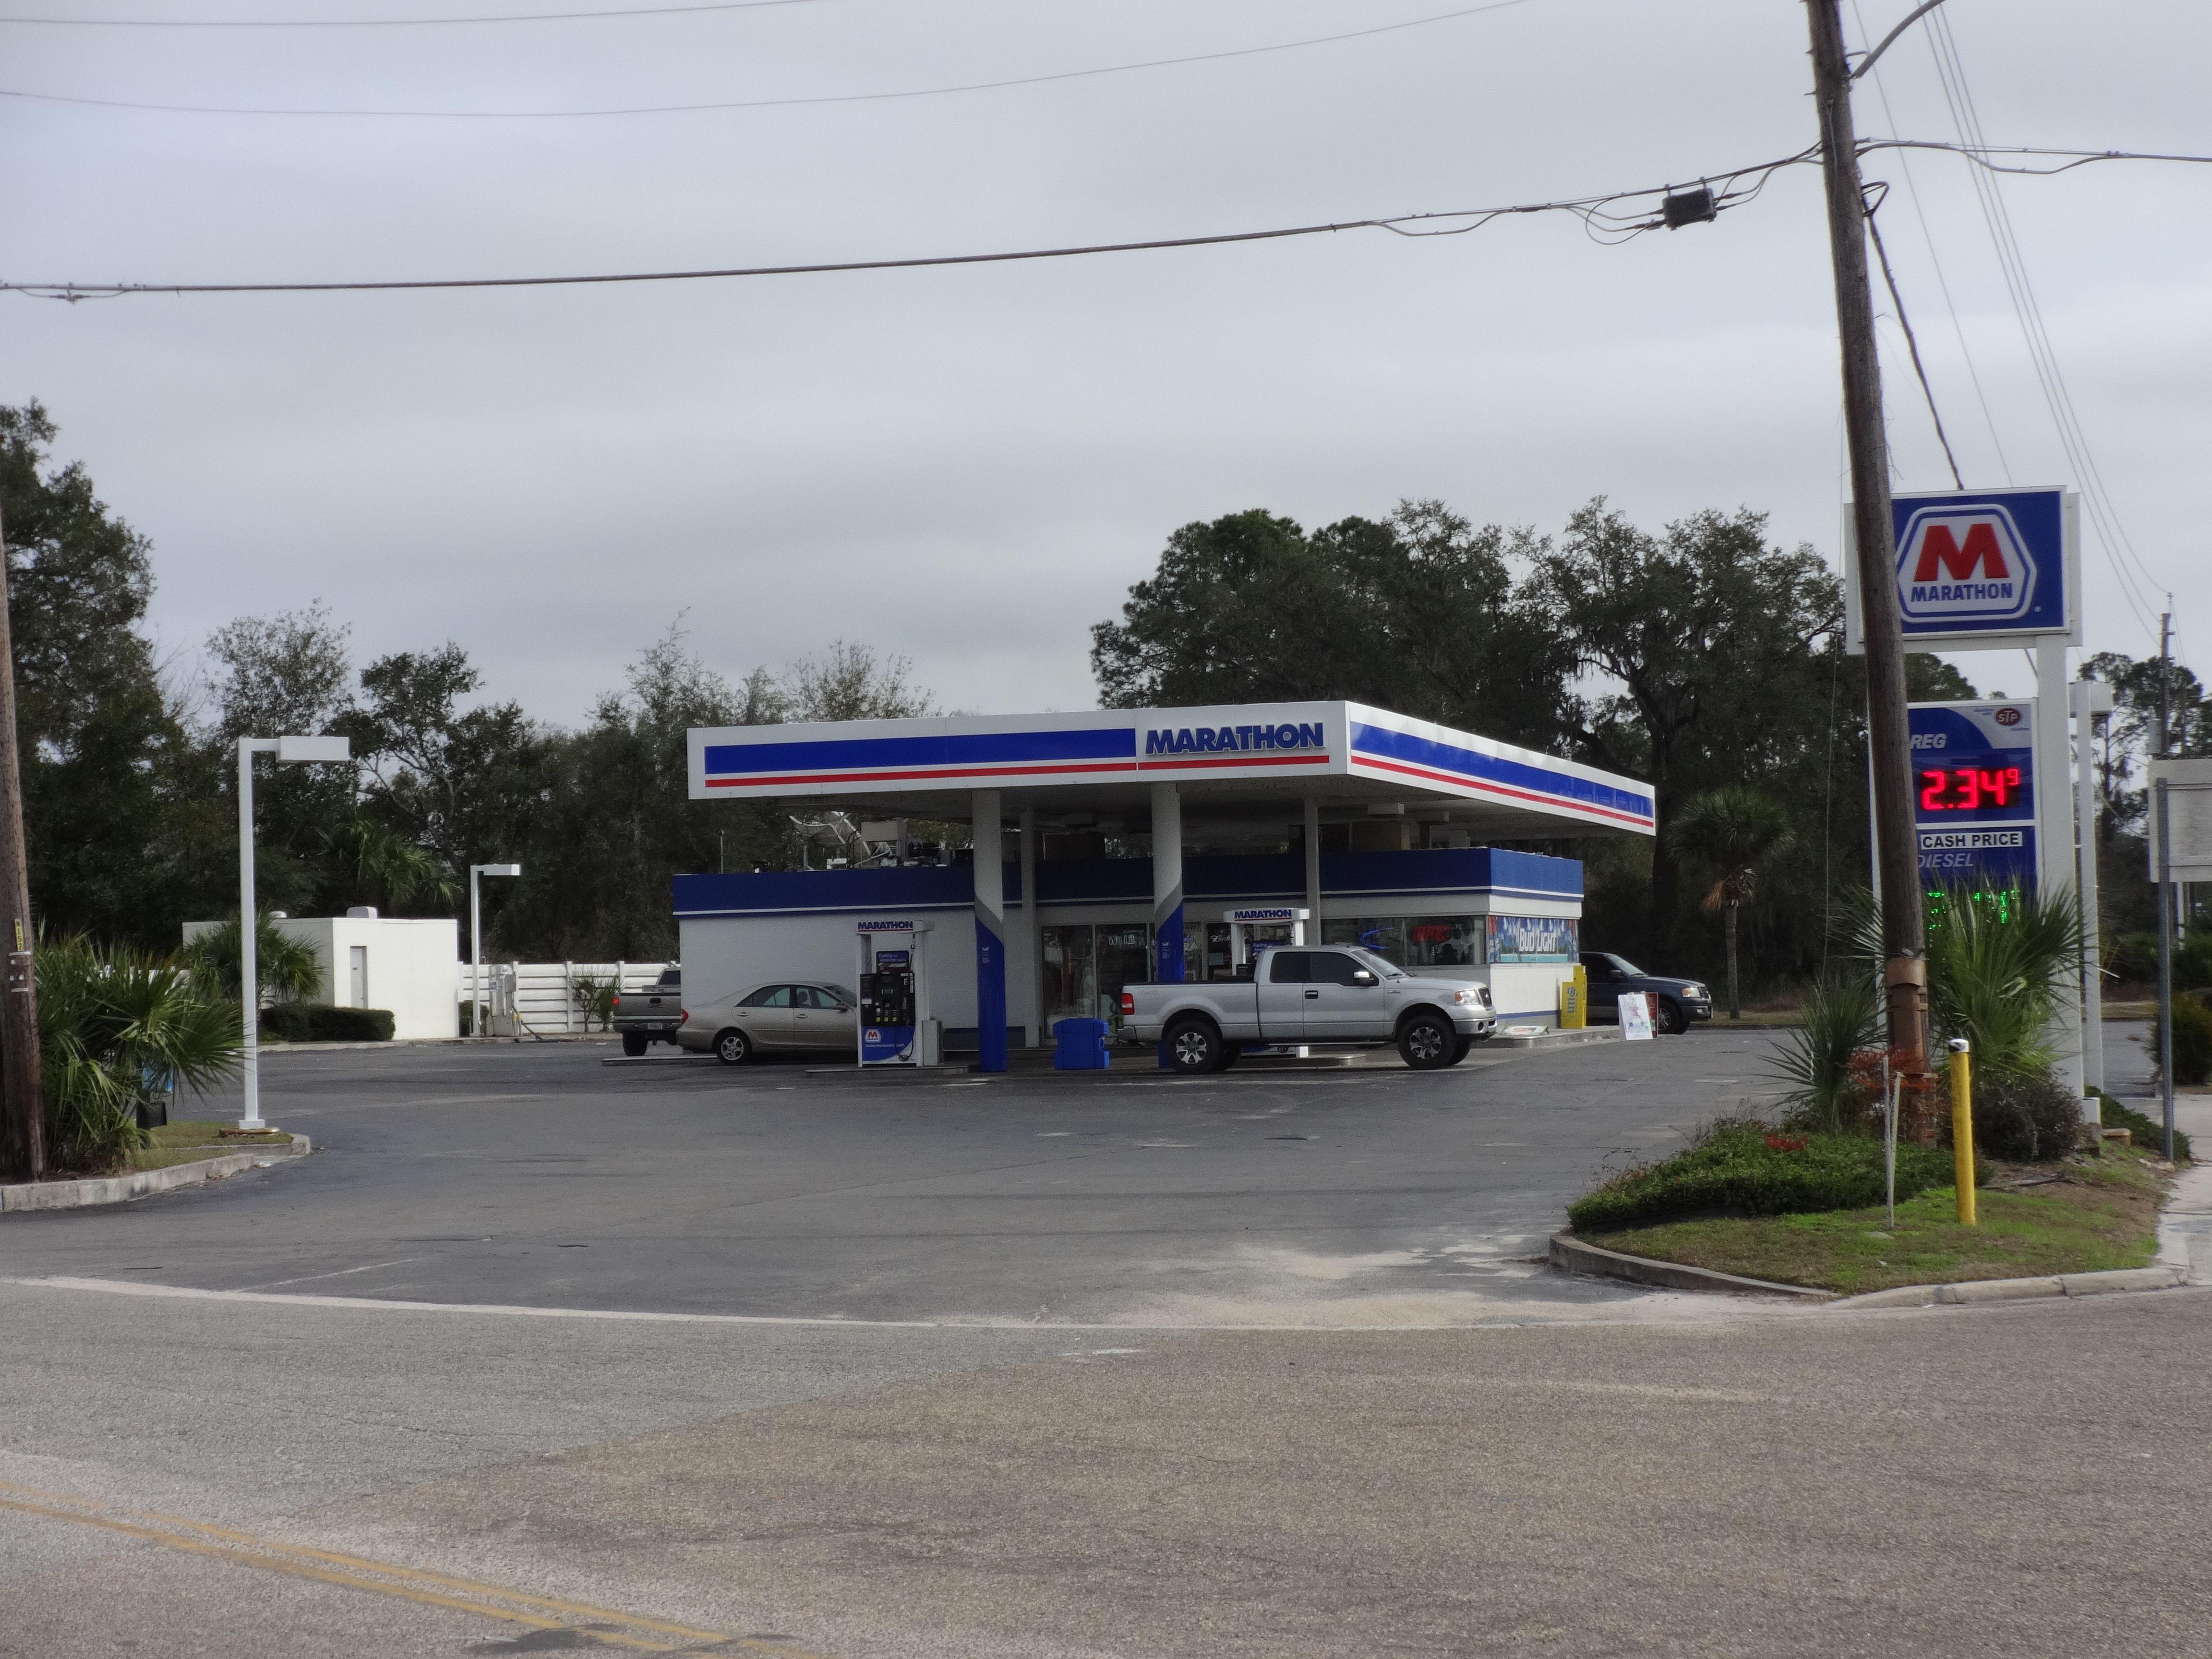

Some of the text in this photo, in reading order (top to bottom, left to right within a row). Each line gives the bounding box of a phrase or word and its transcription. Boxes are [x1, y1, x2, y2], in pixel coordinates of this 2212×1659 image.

[1913, 523, 2009, 582] M
[1911, 583, 2013, 602] MARATHON
[1998, 710, 2017, 722] STP
[1145, 722, 1325, 756] MARATHON
[1910, 733, 1947, 749] REG
[1922, 832, 2020, 848] CASH PRICE
[1918, 853, 1974, 868] DIESEL
[1234, 909, 1292, 919] MARATHON
[858, 921, 914, 929] MARATHON
[1519, 928, 1557, 952] BUD LIGHT
